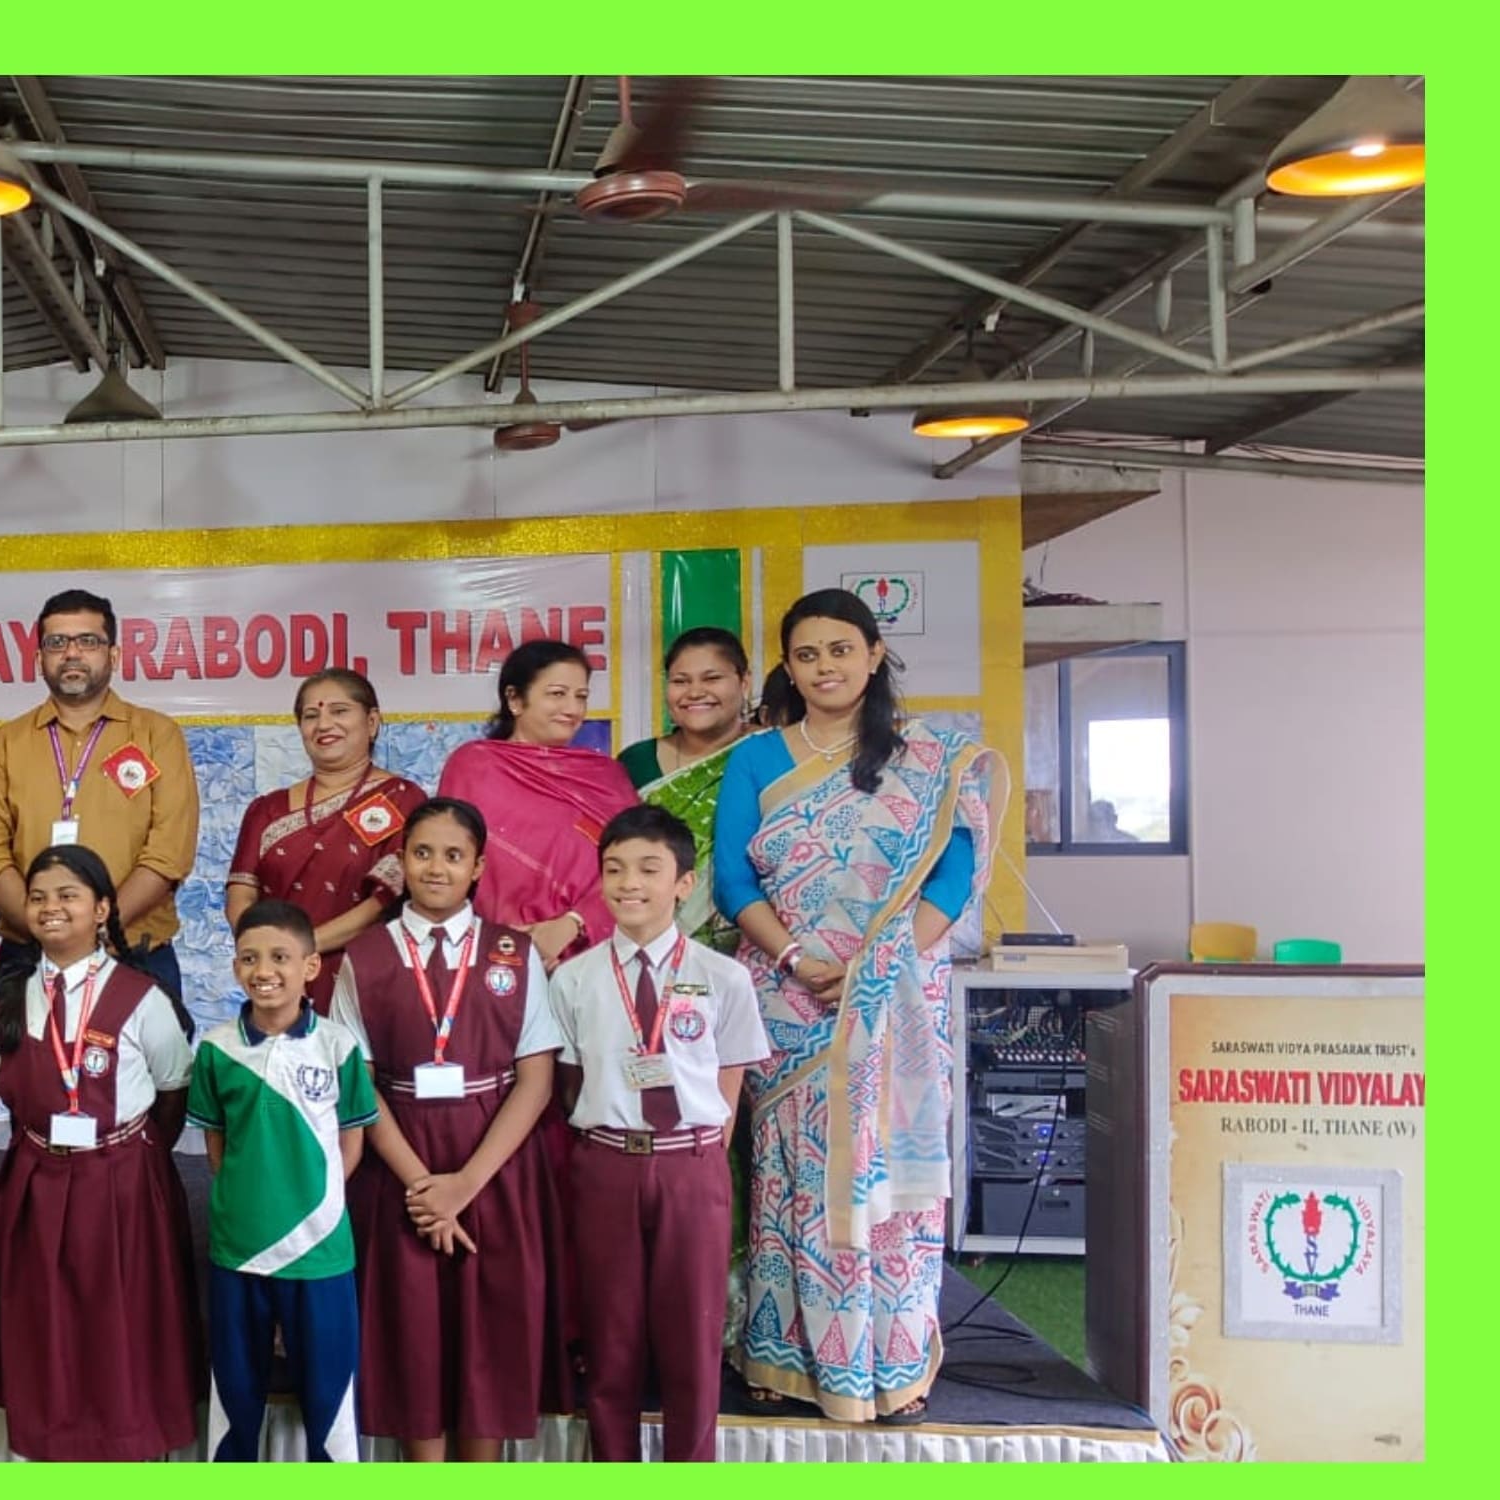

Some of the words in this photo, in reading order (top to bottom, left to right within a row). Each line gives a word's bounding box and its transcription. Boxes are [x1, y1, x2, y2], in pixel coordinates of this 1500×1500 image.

[1211, 1041, 1275, 1054] SARASWATI
[1277, 1042, 1311, 1055] VIDYA
[1313, 1043, 1372, 1056] PRASARAK
[1178, 1067, 1311, 1105] SARASWATI
[1317, 1071, 1425, 1107] VIDYALAY
[1220, 1116, 1288, 1135] RABODI
[1325, 1119, 1383, 1137] THANE
[1387, 1120, 1416, 1139] (W)
[1292, 1303, 1330, 1317] THANE
